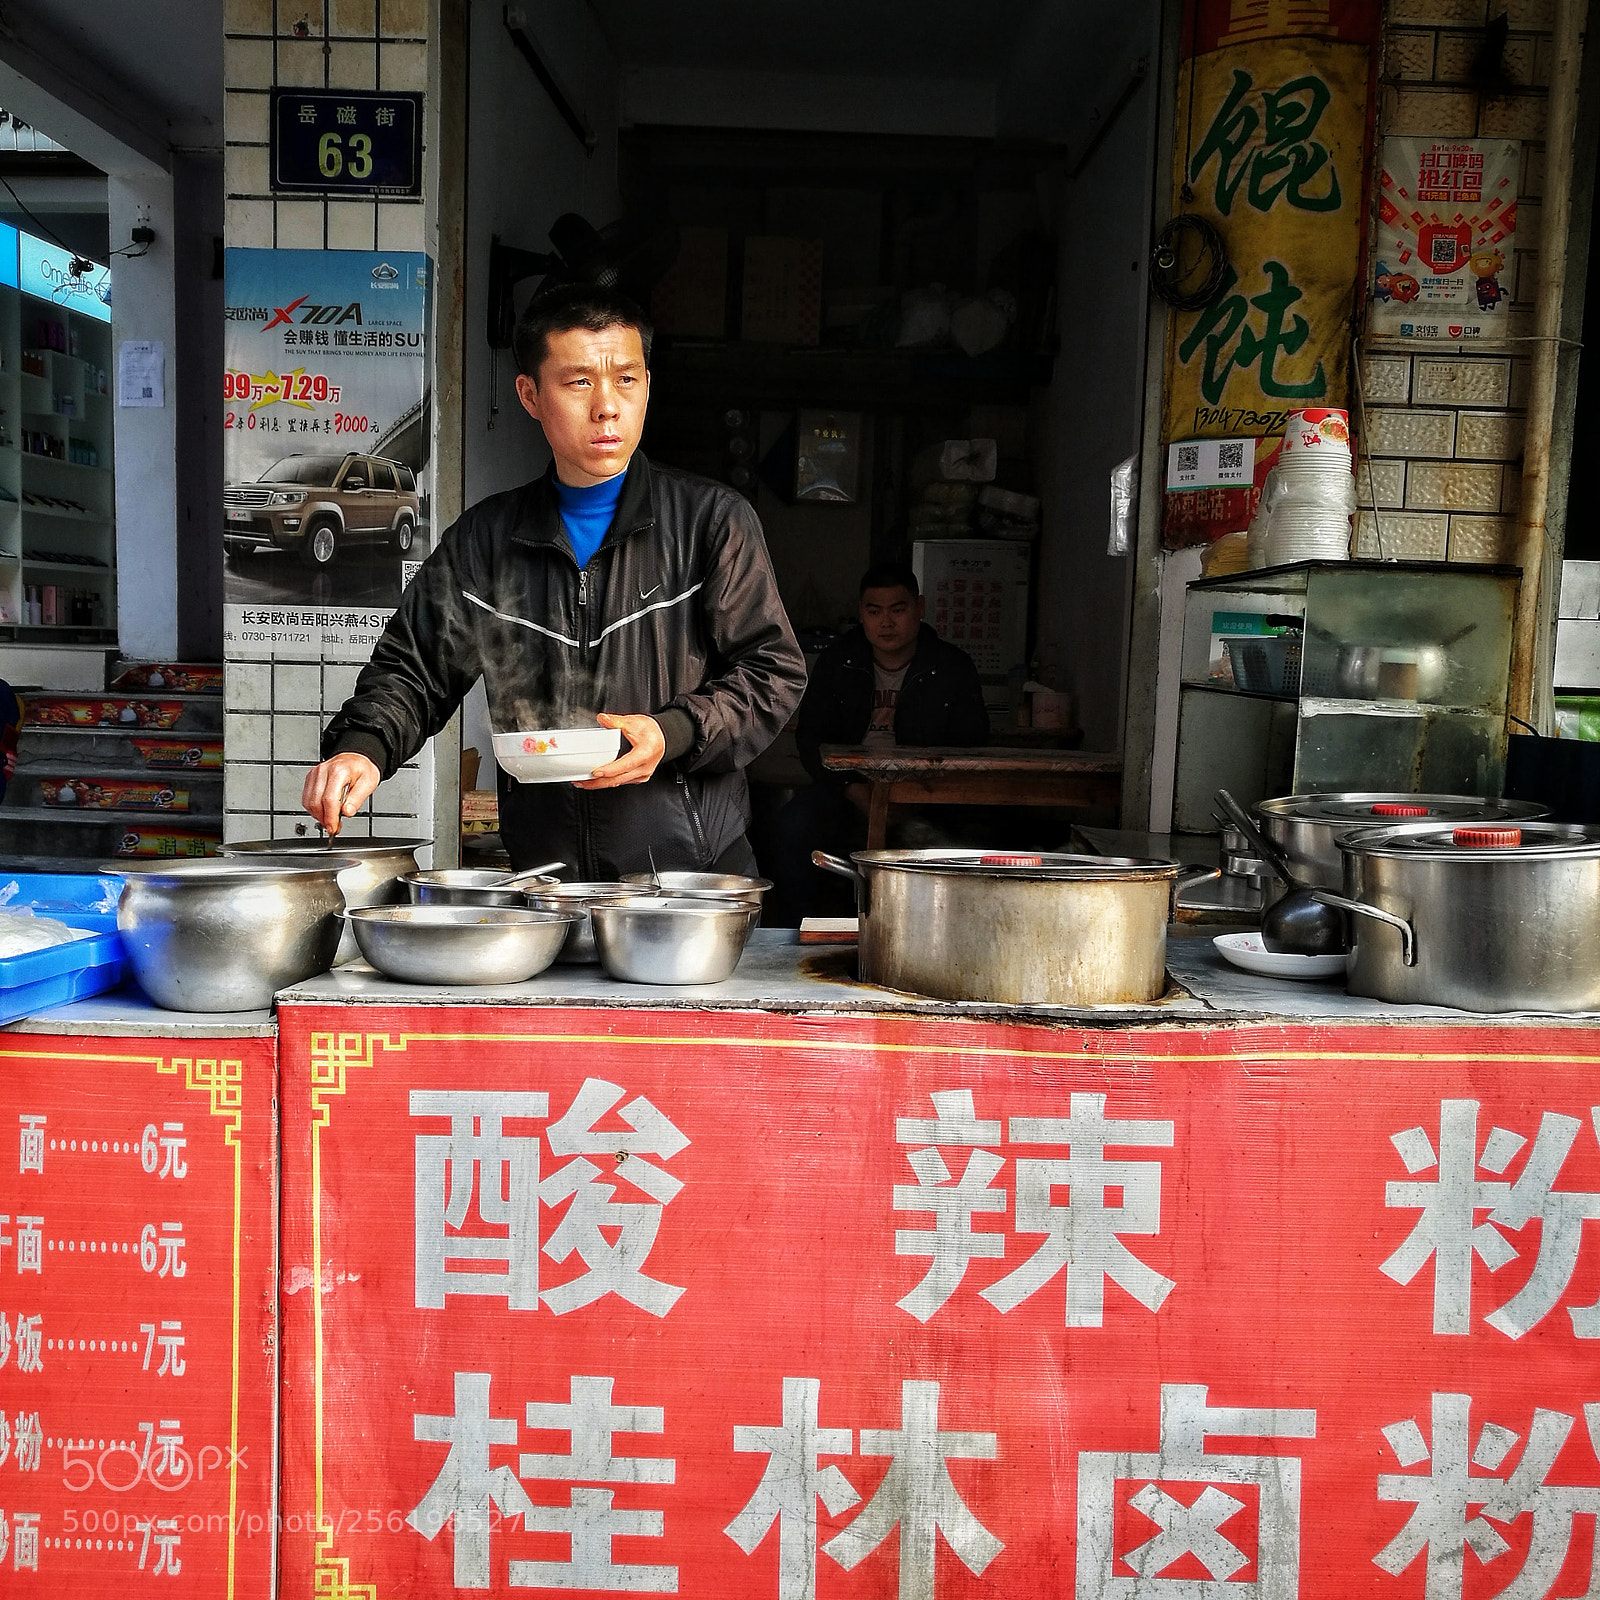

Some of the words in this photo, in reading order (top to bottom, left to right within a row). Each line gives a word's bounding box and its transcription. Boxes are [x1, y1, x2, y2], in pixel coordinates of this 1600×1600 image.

[298, 105, 395, 127] 岳磁街
[318, 132, 373, 178] 63
[1420, 153, 1484, 168] 扫口碑码
[1418, 170, 1484, 189] 抢红包
[284, 329, 329, 346] 会赚钱
[1415, 325, 1439, 334] 支付宝
[320, 633, 383, 646] 地址：岳阳市
